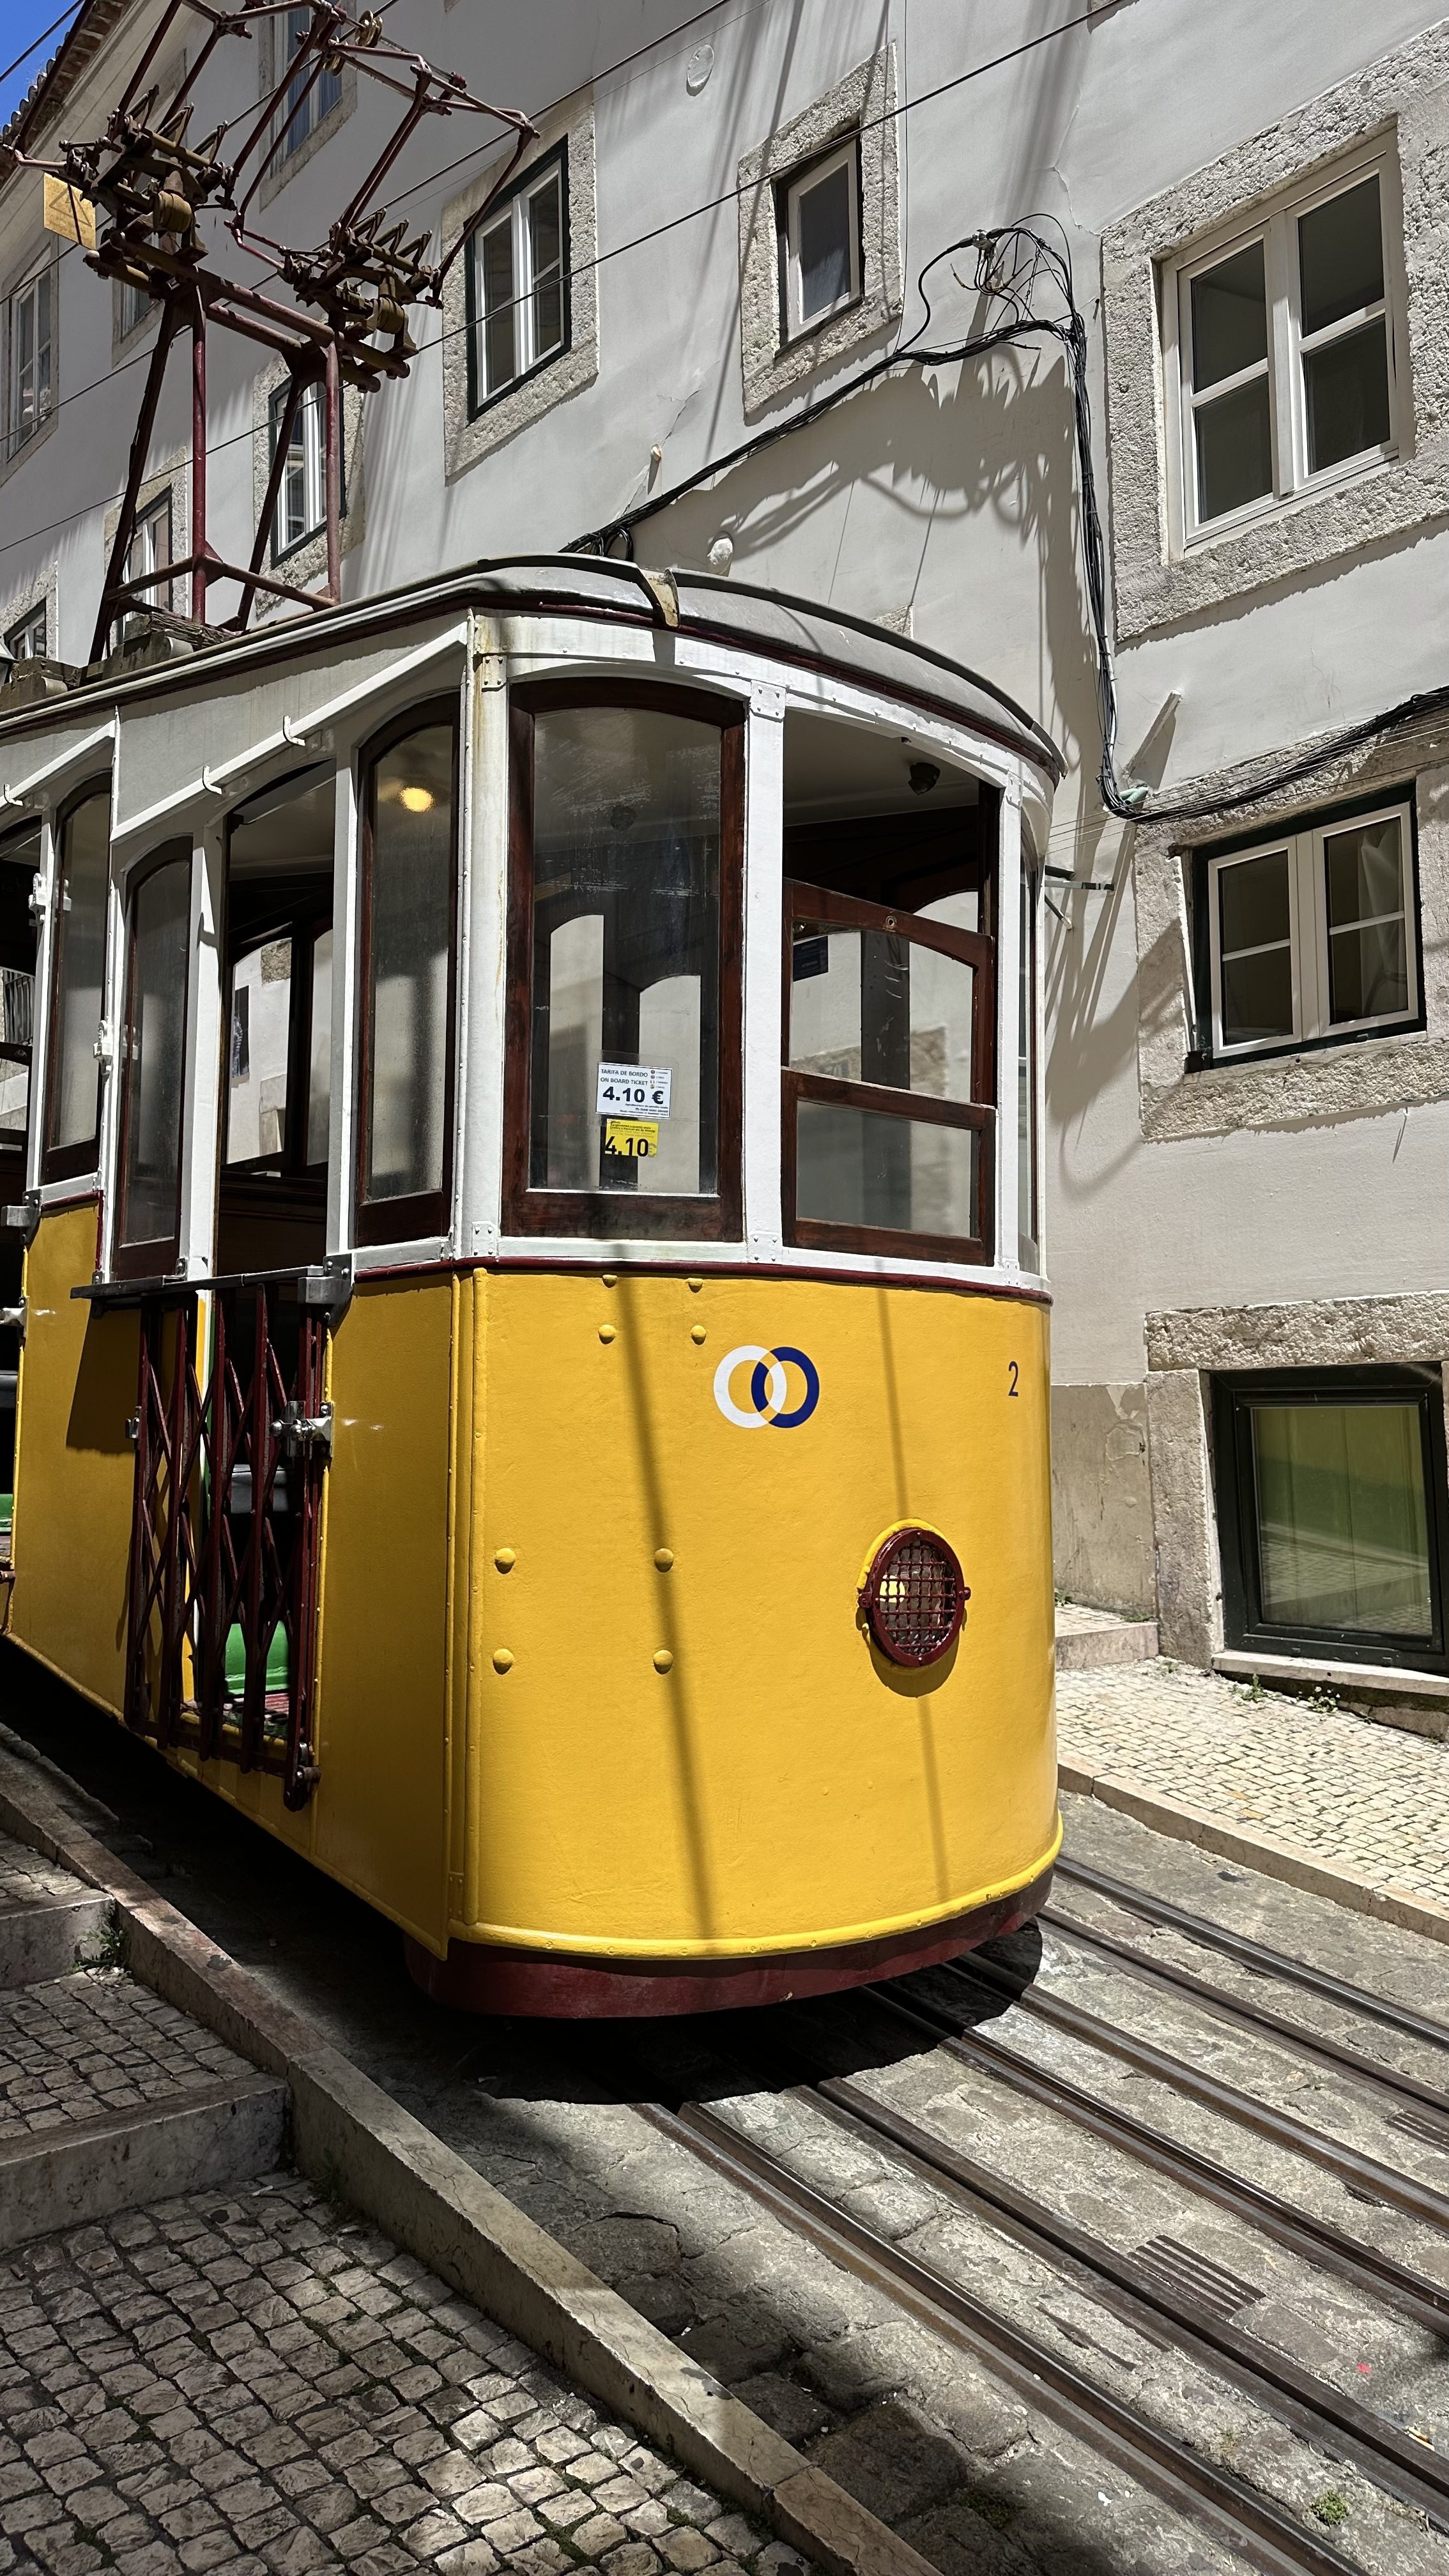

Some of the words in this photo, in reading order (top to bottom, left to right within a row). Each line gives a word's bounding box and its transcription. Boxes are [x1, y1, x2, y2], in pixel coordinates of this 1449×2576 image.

[602, 1086, 645, 1103] 4.10
[652, 1090, 664, 1105] €
[1008, 1360, 1019, 1397] 2
